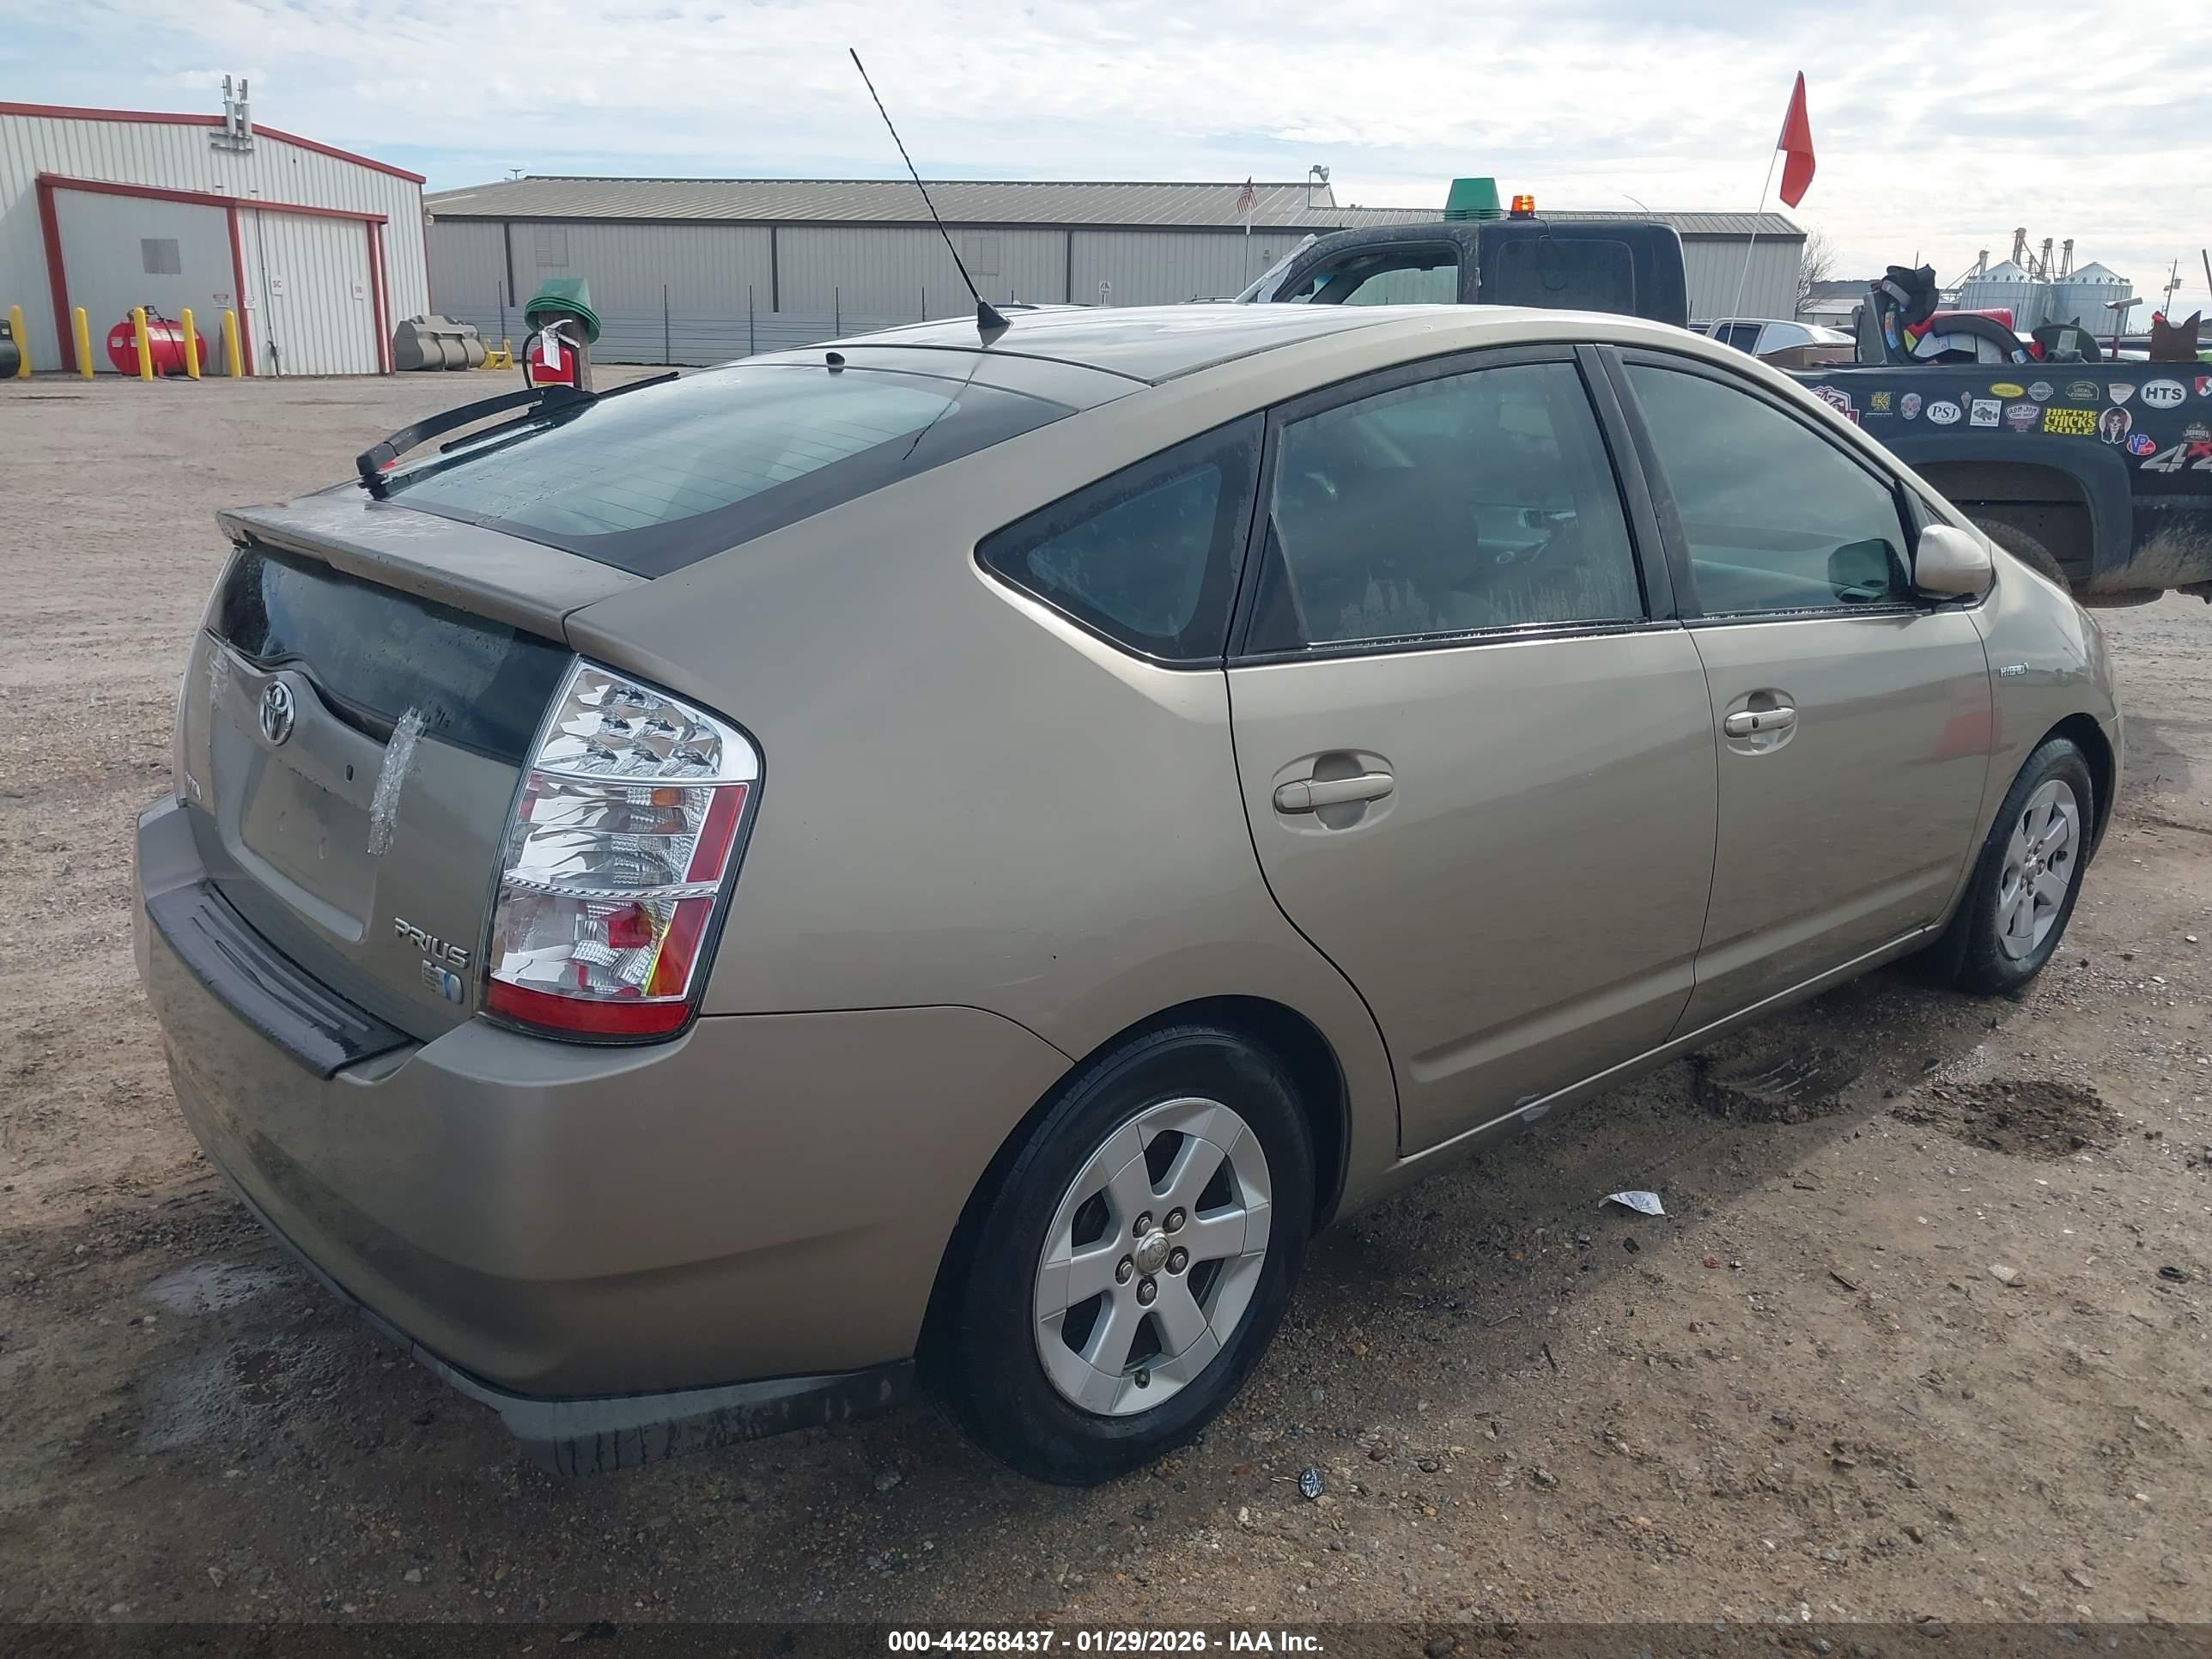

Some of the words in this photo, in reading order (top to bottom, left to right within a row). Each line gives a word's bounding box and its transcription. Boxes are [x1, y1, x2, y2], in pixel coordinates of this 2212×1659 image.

[2145, 386, 2183, 401] HTS
[1931, 405, 1958, 419] PSJ
[2046, 408, 2098, 419] HIPPIE
[2045, 416, 2096, 428] CHICKS
[2044, 424, 2096, 435] RULE
[394, 916, 470, 969] PRIUS
